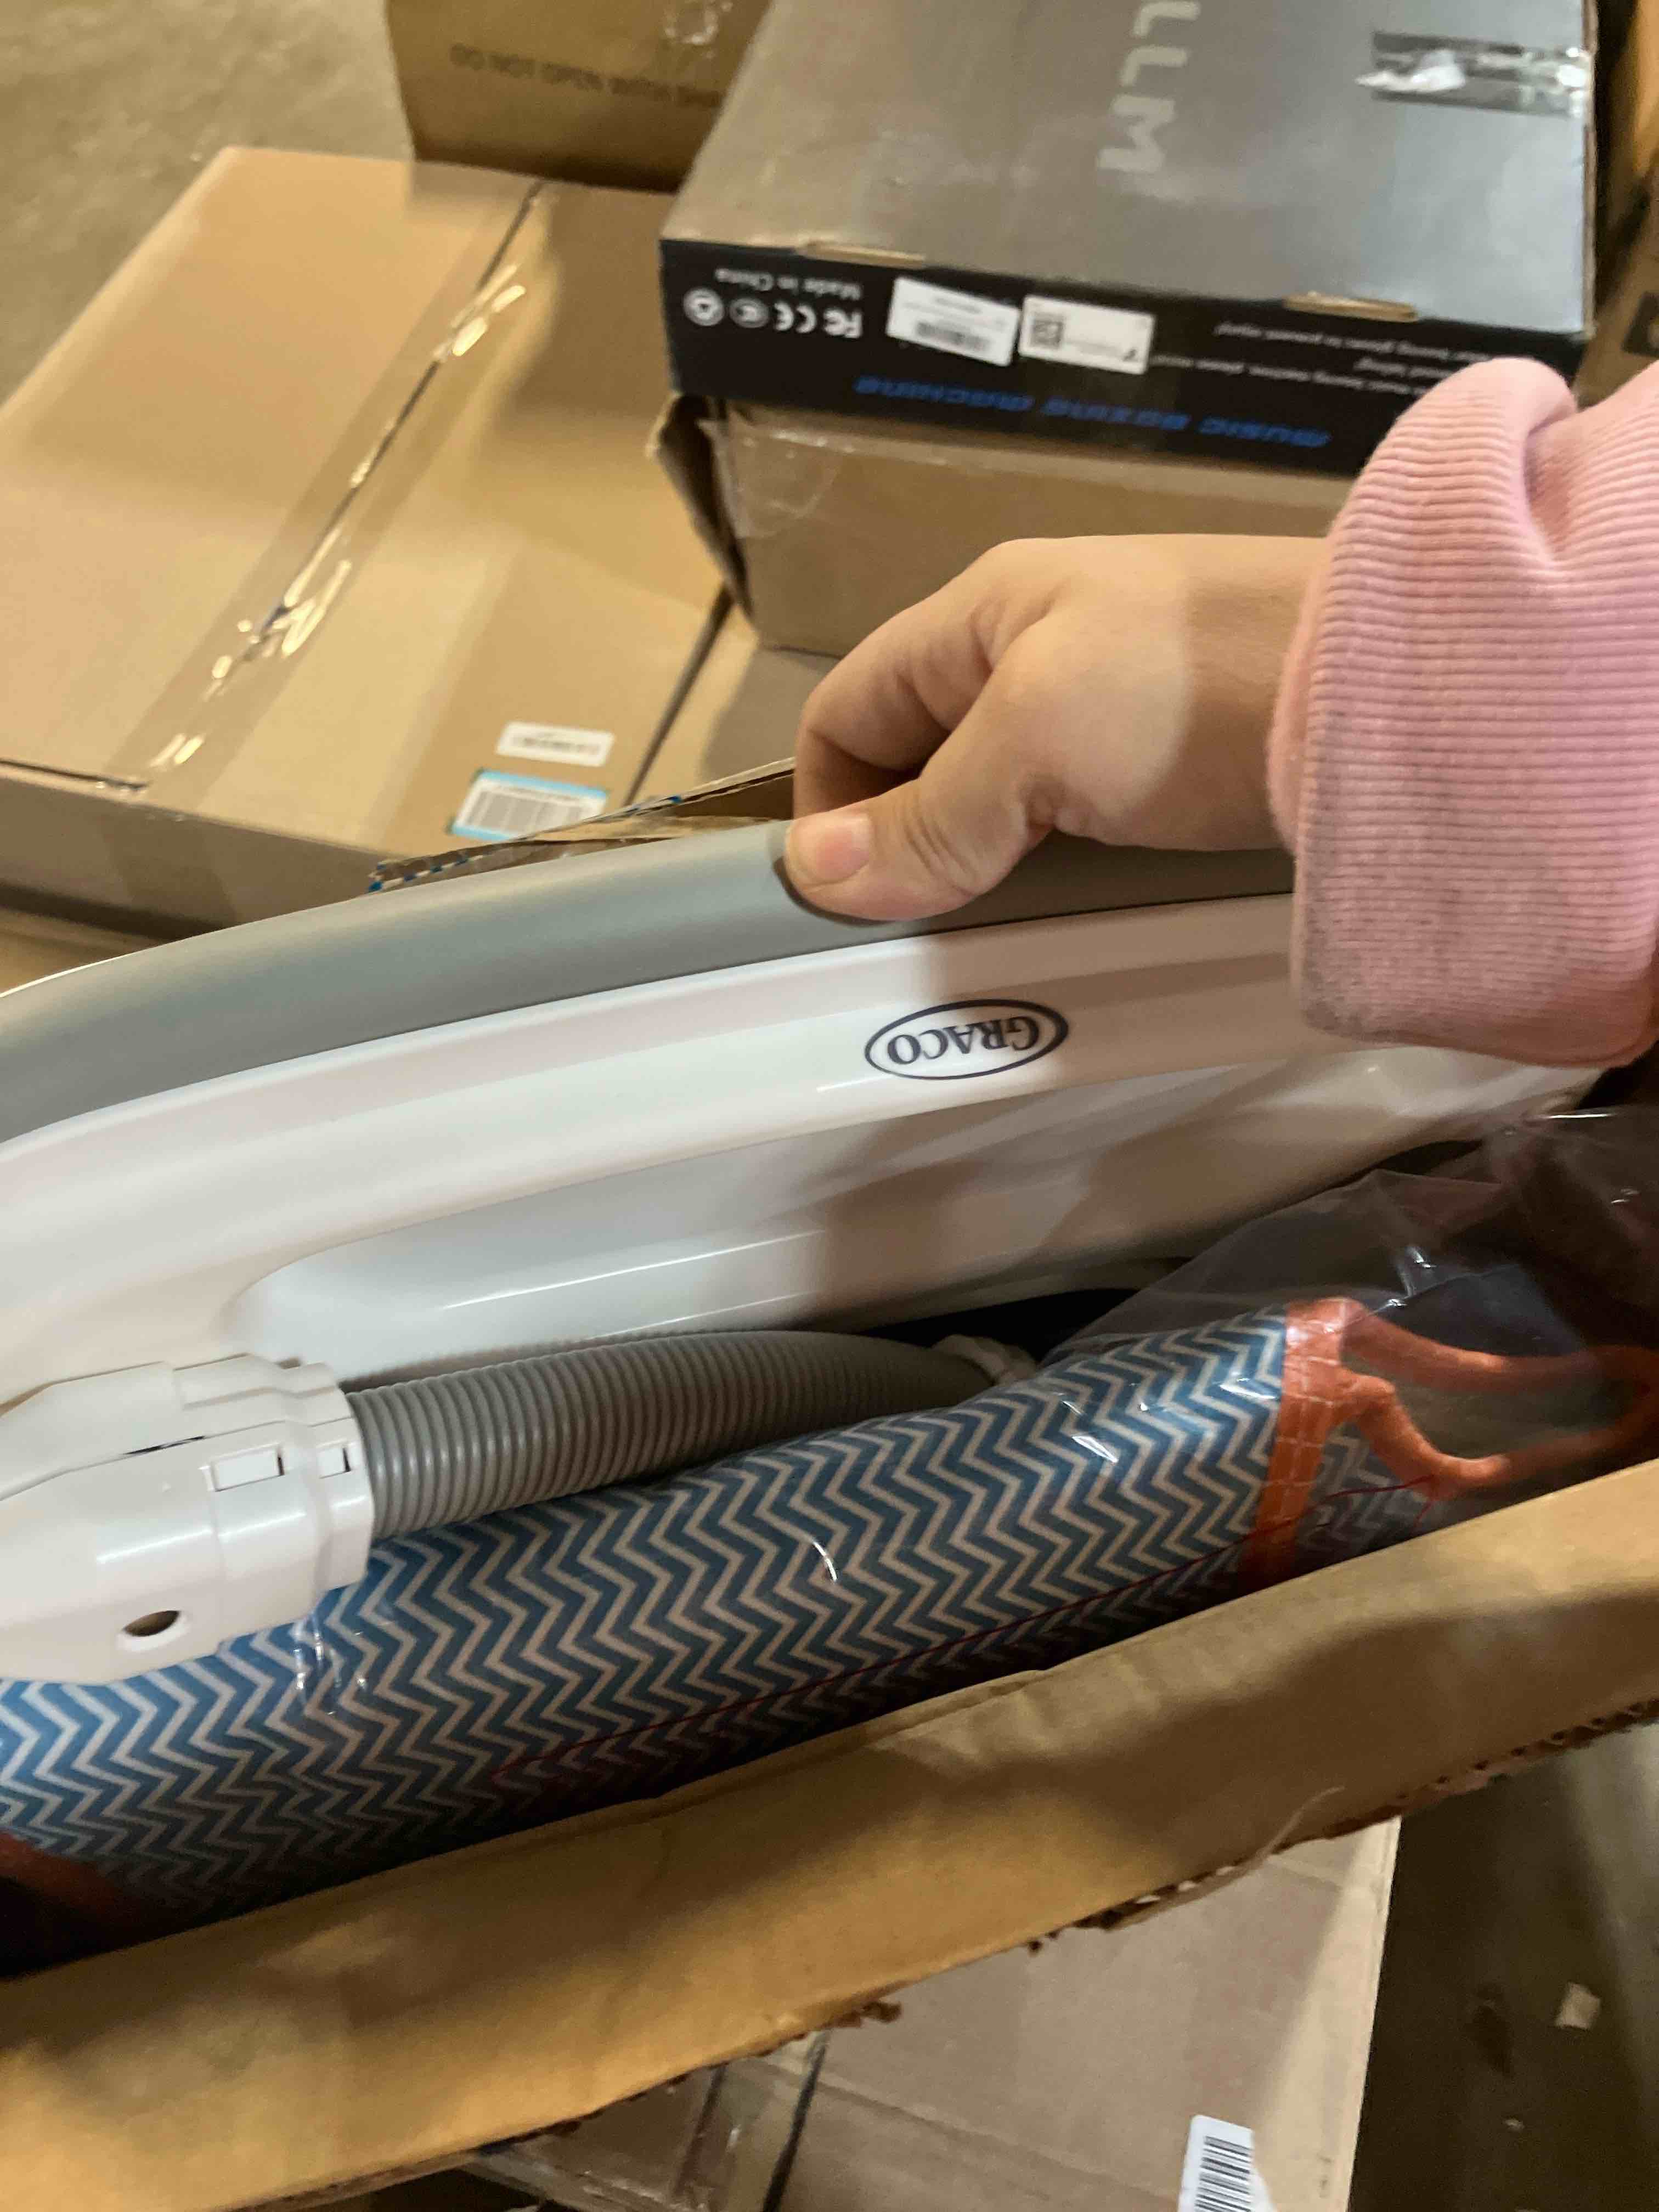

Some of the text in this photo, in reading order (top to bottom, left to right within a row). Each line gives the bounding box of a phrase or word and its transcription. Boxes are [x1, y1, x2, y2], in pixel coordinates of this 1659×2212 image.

[715, 268, 862, 301] Made in China
[887, 1016, 1039, 1065] GRACO
